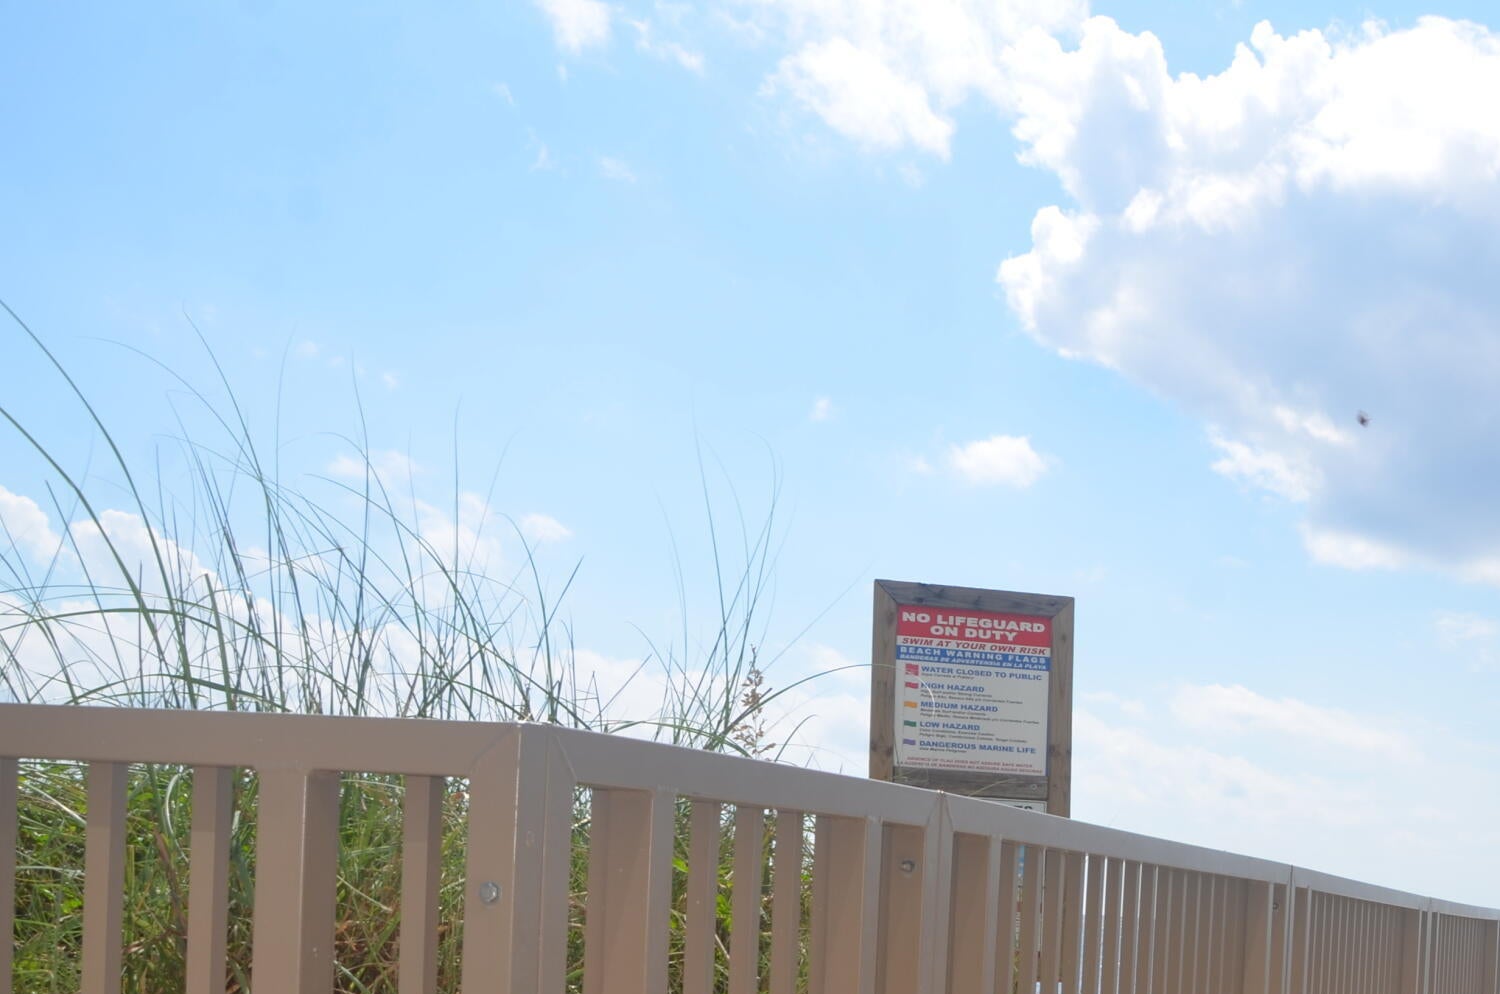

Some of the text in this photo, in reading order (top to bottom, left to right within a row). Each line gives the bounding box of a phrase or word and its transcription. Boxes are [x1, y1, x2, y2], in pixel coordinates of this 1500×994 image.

[902, 612, 1045, 633] NO LIFEGUARD
[930, 625, 1018, 642] ON DUTY
[902, 637, 1046, 655] SWIM AT YOUR OWN RISK
[901, 646, 1046, 664] BEACH WARNING FLAGS
[921, 665, 954, 675] WATER
[956, 668, 992, 678] CLOSED
[995, 671, 1007, 679] TO
[1009, 672, 1042, 681] PUBLIC
[921, 682, 985, 693] HIGH HAZARD
[920, 701, 998, 712] MEDIUM HAZARD
[919, 721, 980, 731] LOW HAZARD
[919, 740, 1037, 754] DANGEROUS MARINE LIFE
